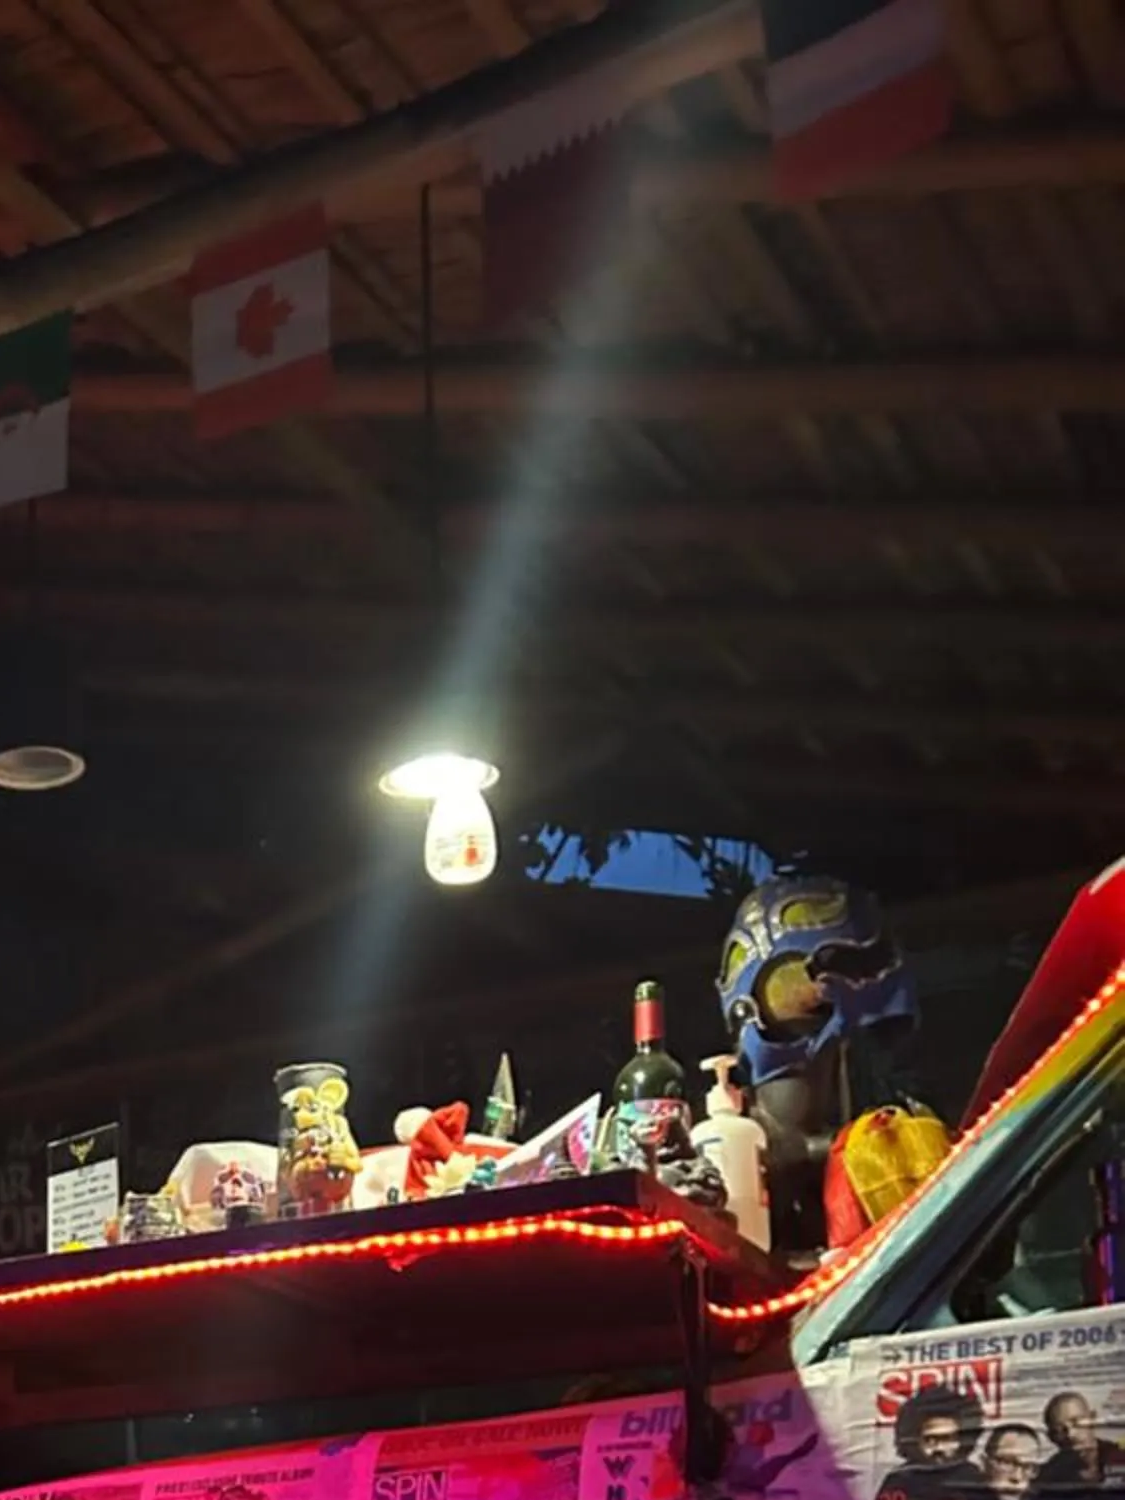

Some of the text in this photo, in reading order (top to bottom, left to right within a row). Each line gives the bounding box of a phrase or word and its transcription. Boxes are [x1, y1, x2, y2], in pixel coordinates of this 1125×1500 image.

[904, 1324, 1116, 1363] THE BEST OF 2006
[877, 1360, 1000, 1420] SPIN
